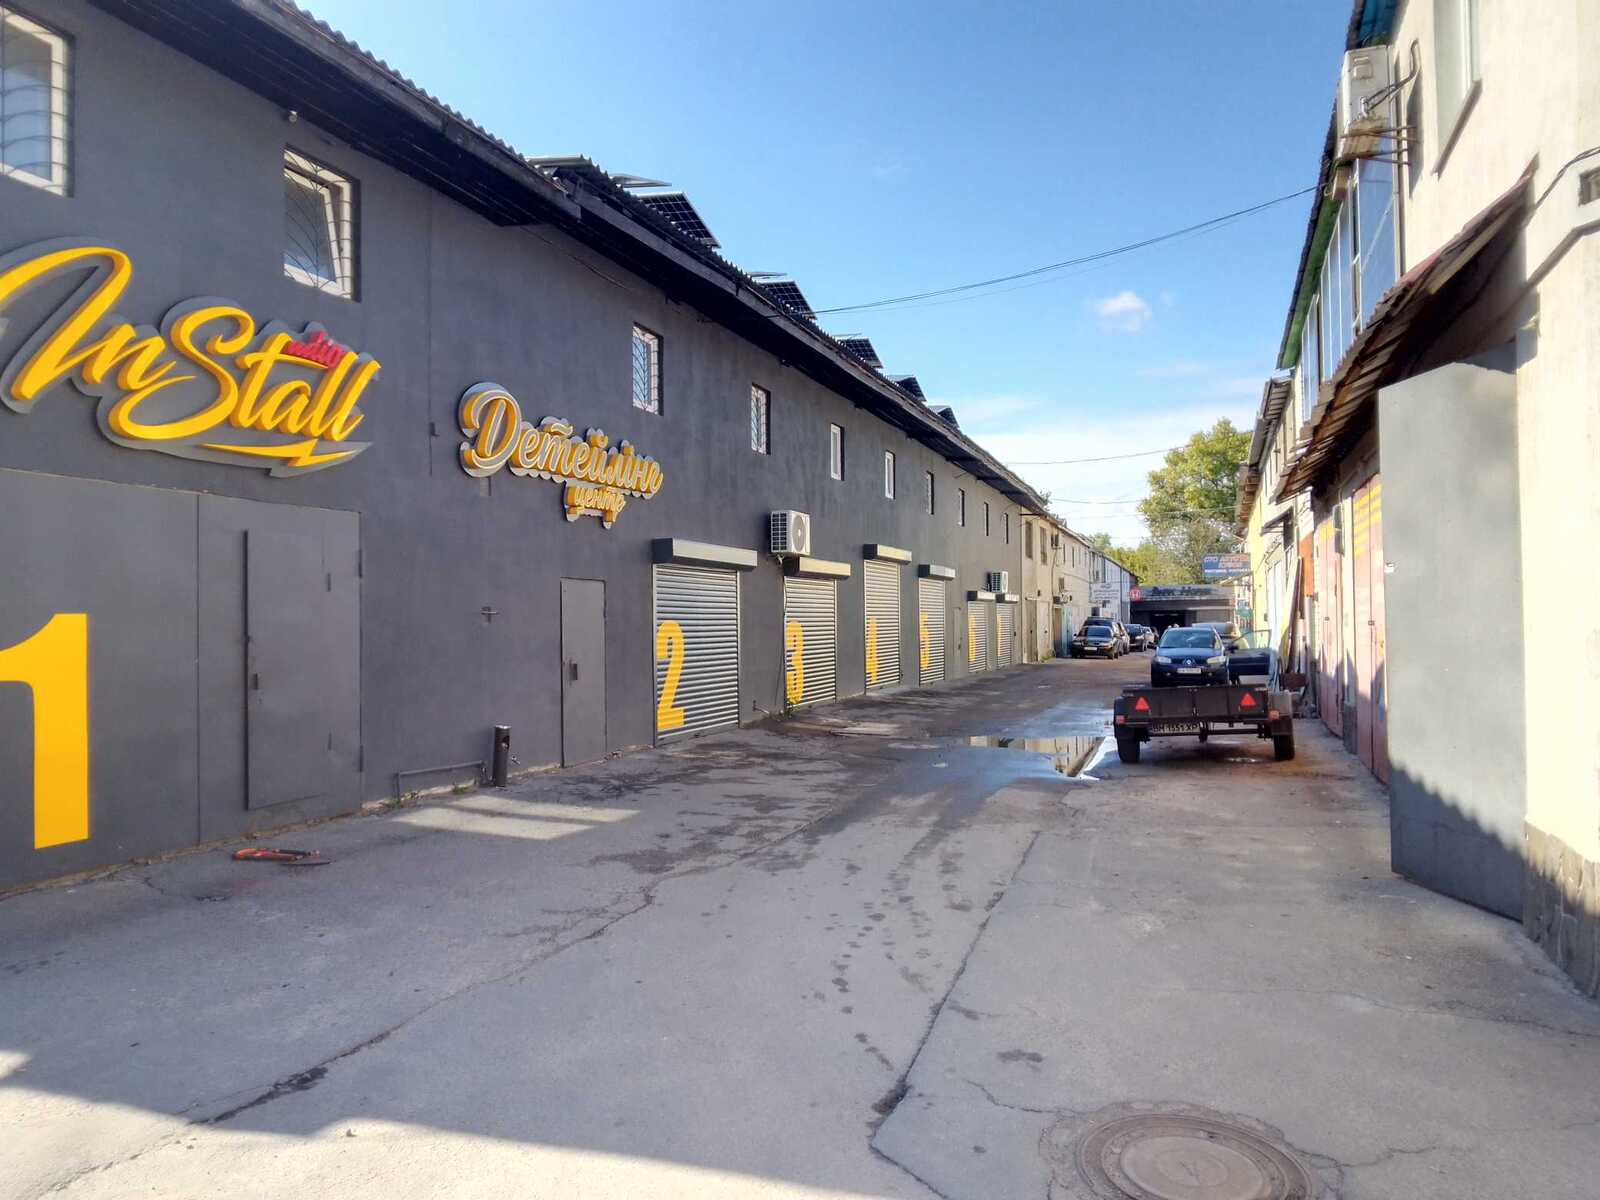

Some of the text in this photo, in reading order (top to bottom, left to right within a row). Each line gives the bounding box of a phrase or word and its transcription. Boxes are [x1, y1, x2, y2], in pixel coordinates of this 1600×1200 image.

[656, 620, 686, 732] 2
[786, 618, 805, 705] 3
[0, 613, 89, 849] 1
